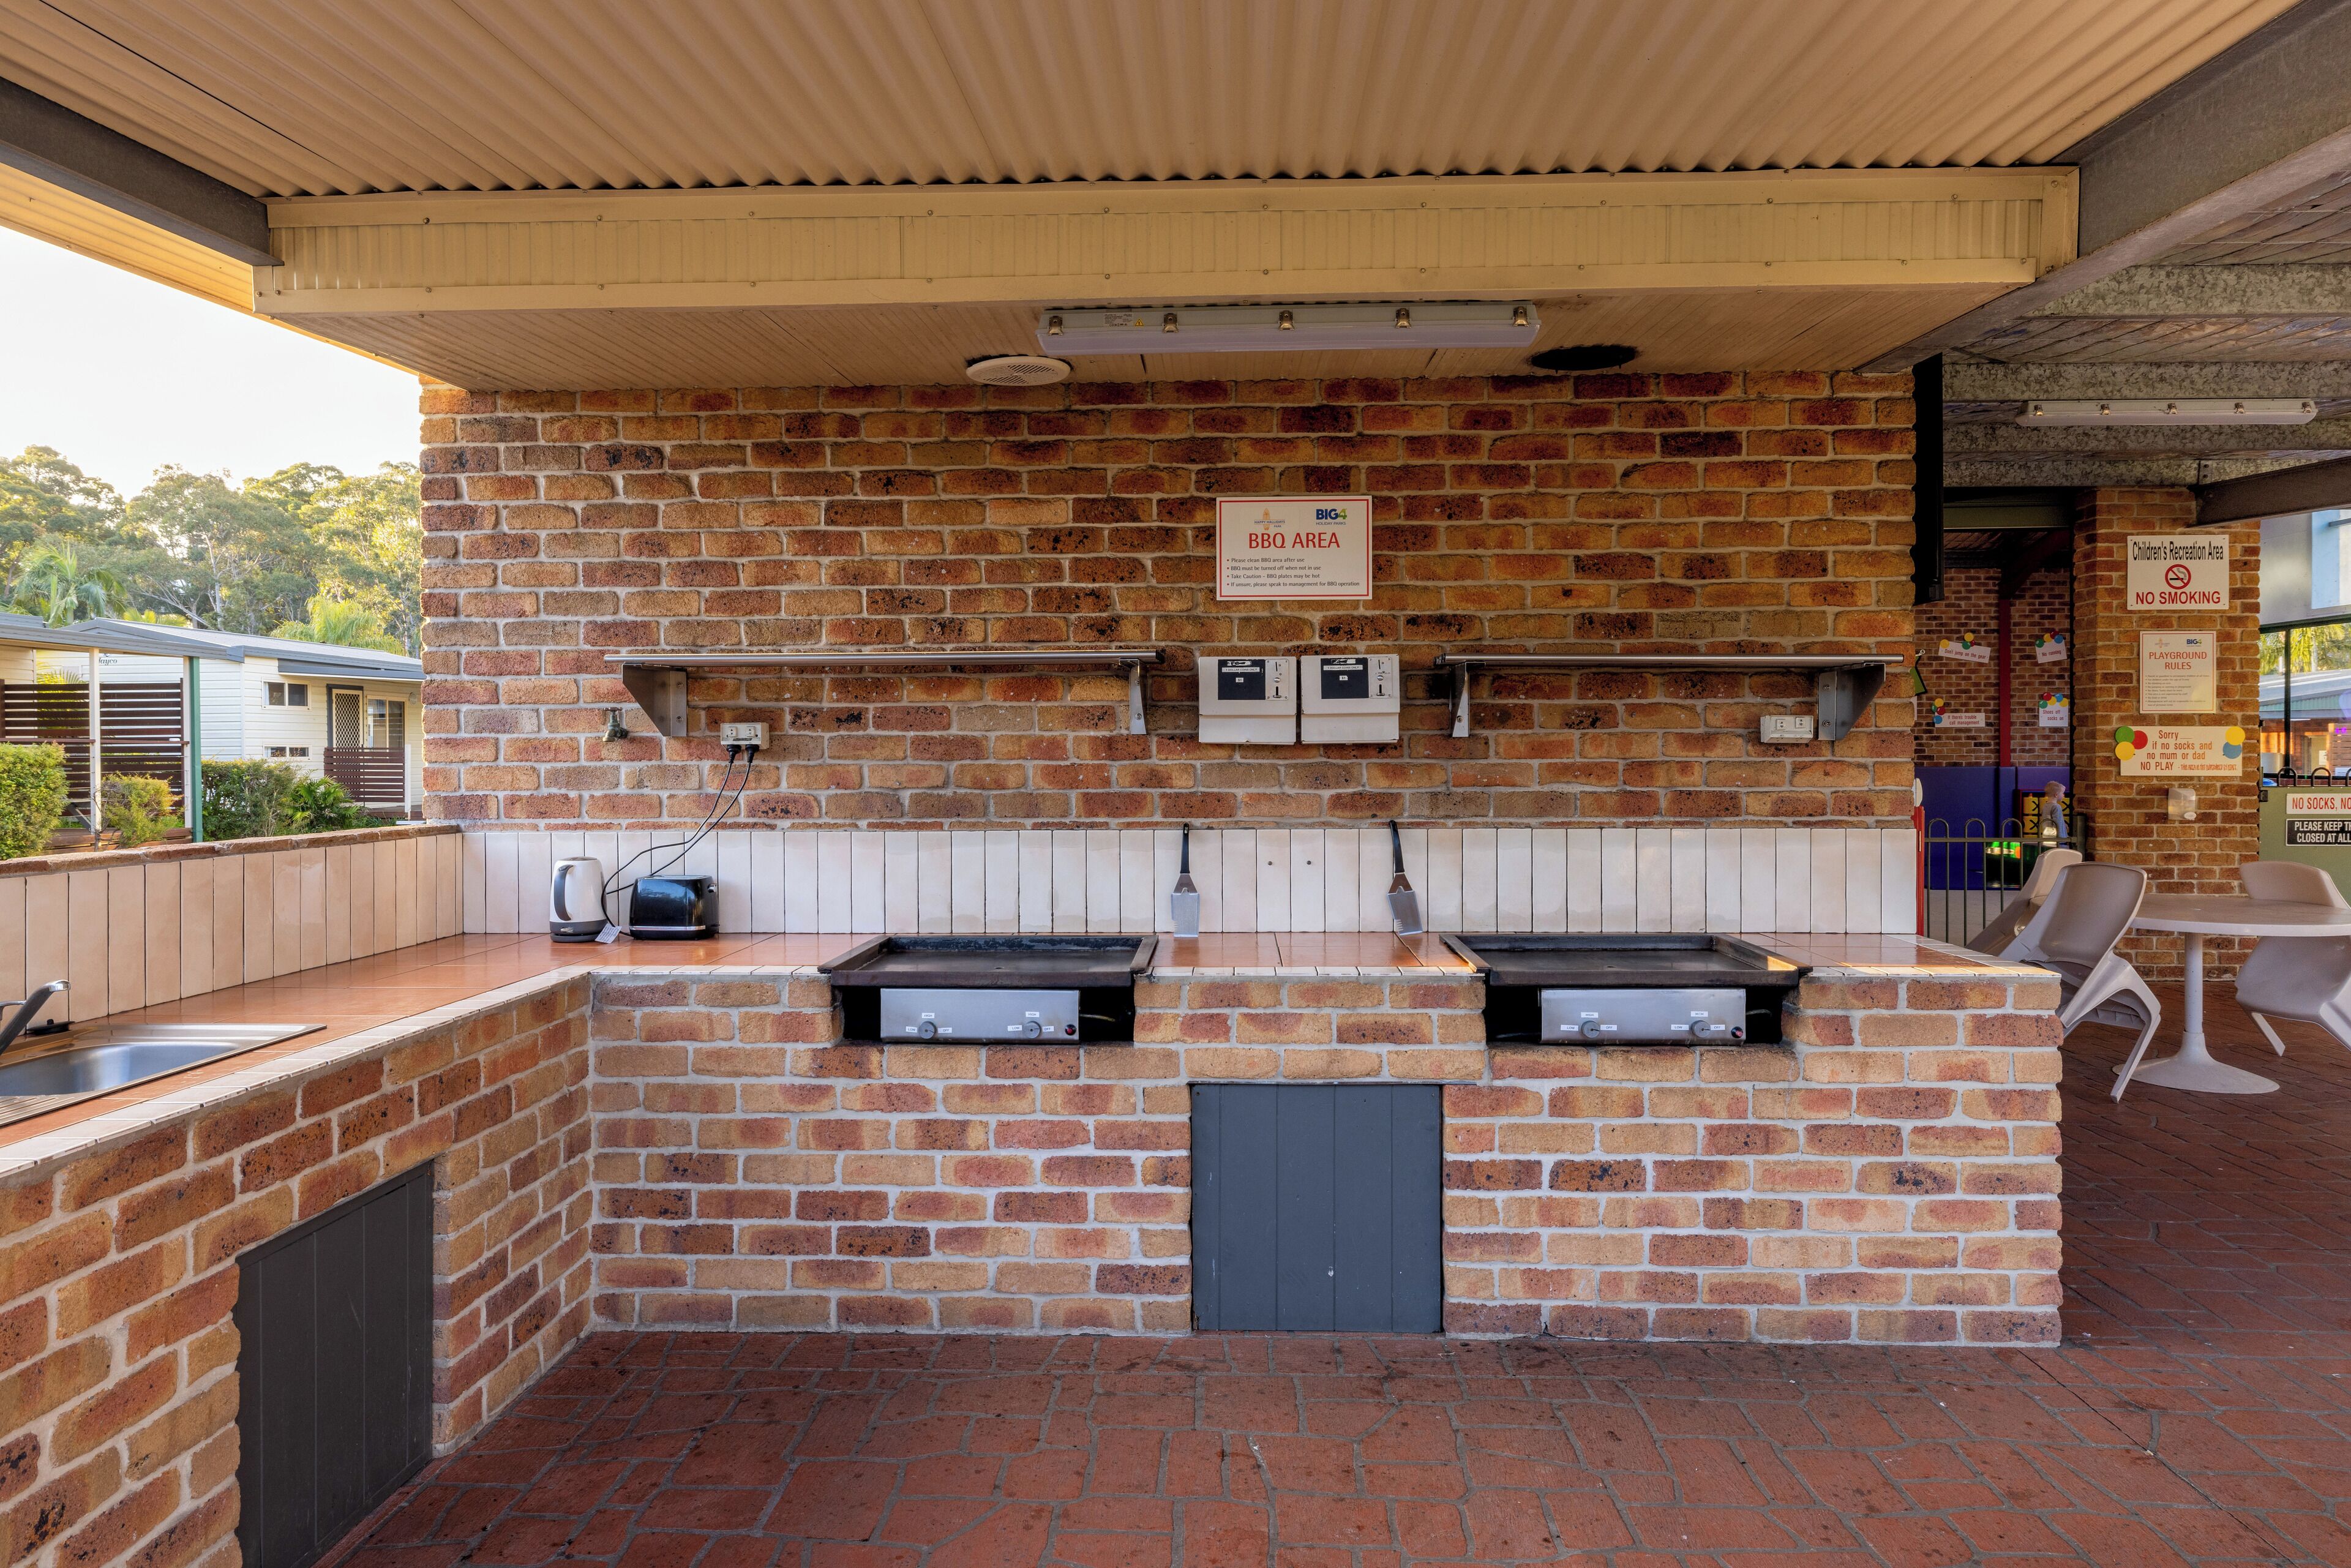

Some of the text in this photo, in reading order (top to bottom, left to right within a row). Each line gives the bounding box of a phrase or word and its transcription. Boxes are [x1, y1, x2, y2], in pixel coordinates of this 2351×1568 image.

[1316, 508, 1347, 520] BIG4
[1249, 533, 1340, 549] BBQ AREA
[2132, 541, 2224, 561] Children's Recreation Area
[2136, 591, 2221, 605] NO SMOKING
[2159, 730, 2179, 740] Sorry
[2141, 762, 2173, 770] NO PLAY
[2292, 797, 2304, 809] NO
[2307, 797, 2338, 811] SOCKS,
[2295, 822, 2322, 830] PLEASE
[2324, 822, 2342, 830] KEEP
[2297, 833, 2325, 842] CLOSED
[2327, 833, 2336, 842] AT
